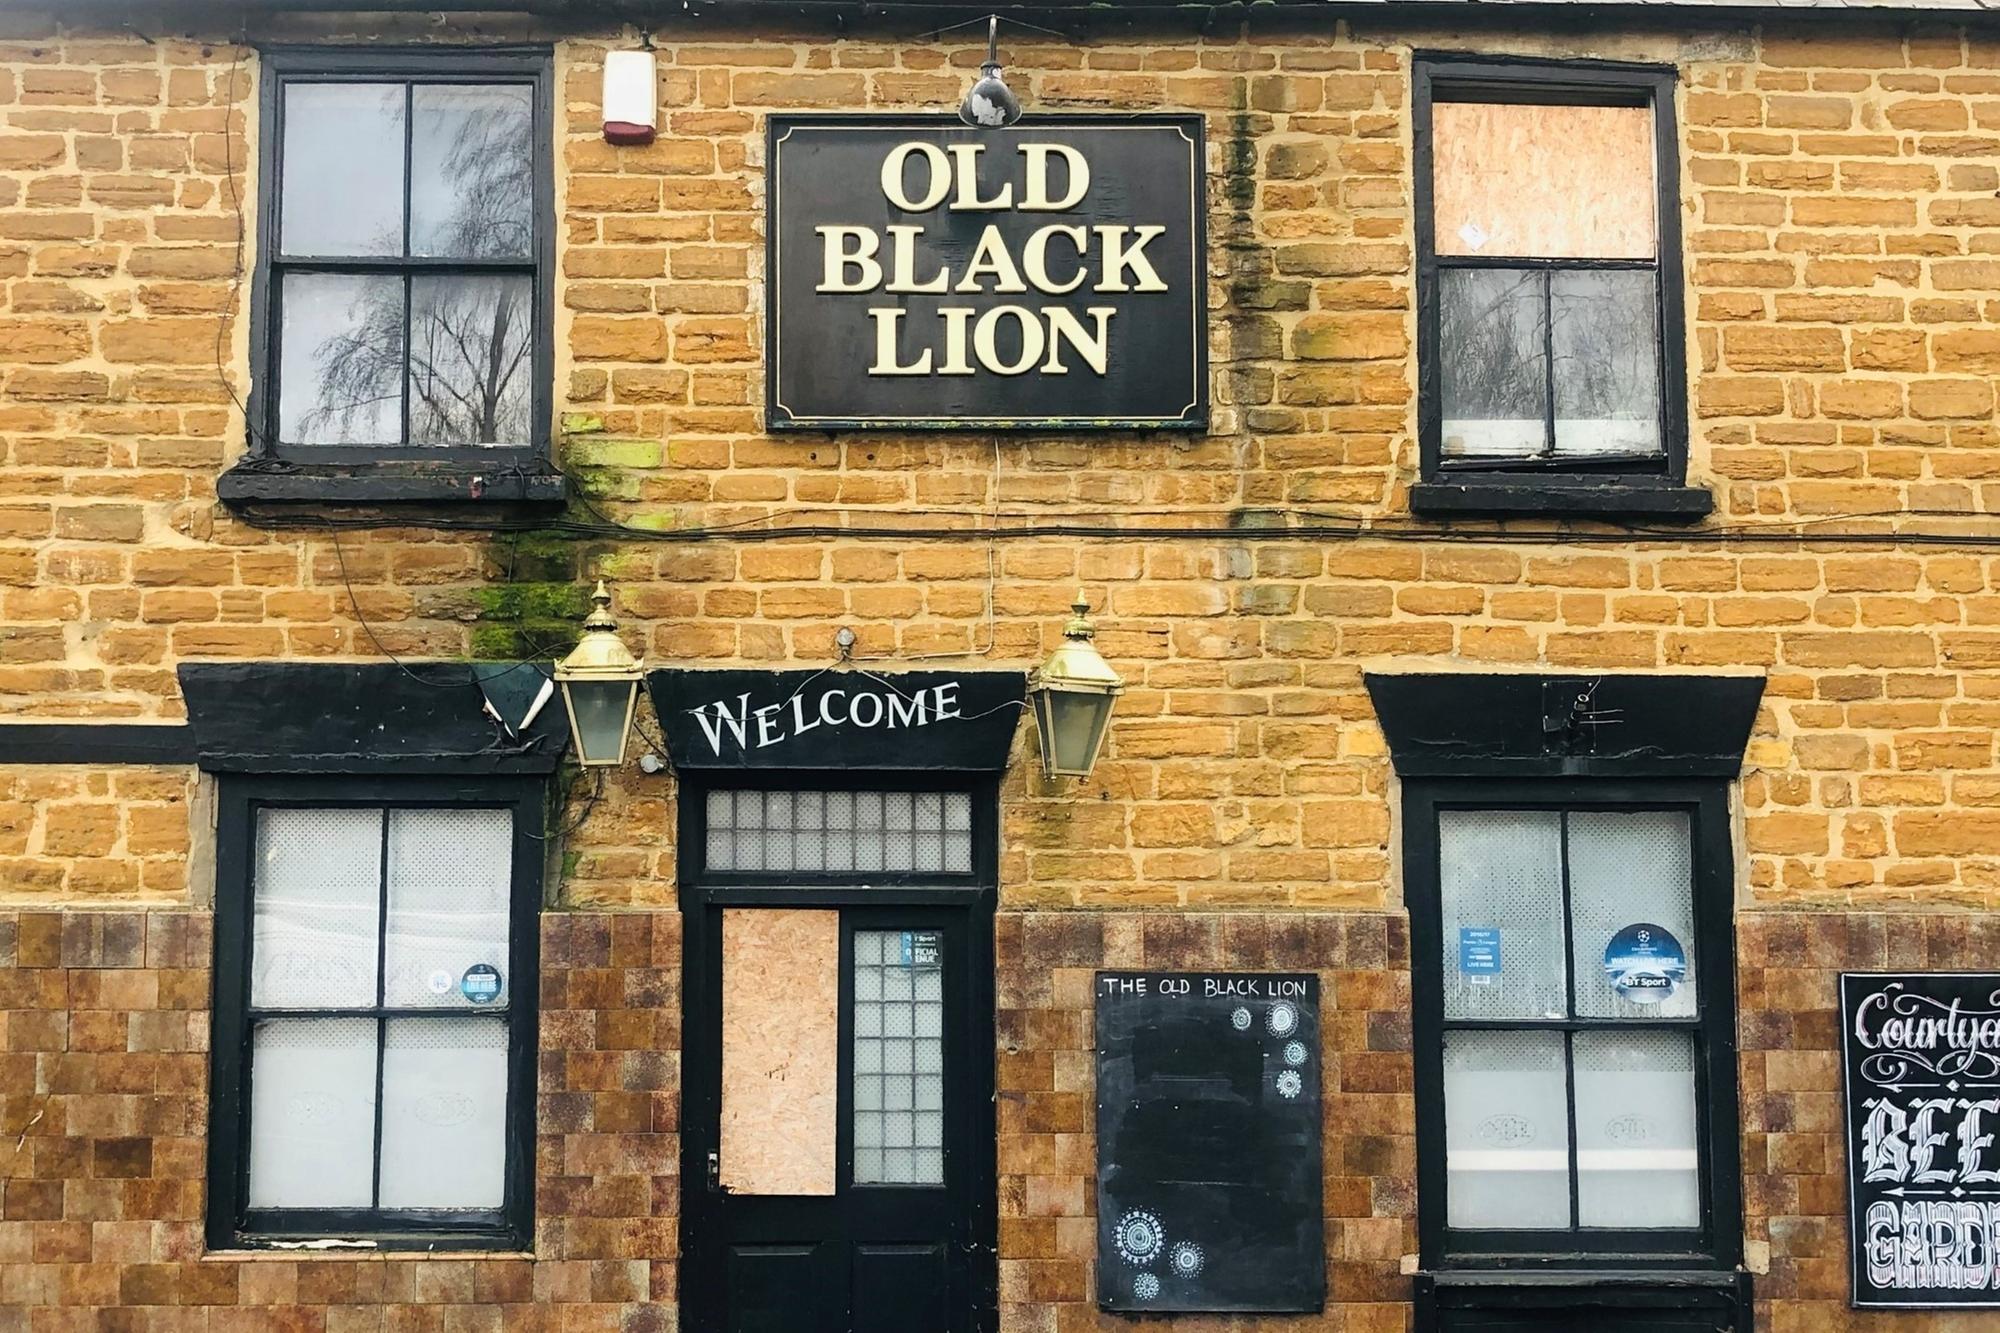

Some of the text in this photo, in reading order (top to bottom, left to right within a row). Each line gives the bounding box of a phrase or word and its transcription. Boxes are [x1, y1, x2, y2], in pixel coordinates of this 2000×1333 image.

[880, 141, 1090, 213] OLD
[815, 224, 1168, 294] BLACK
[868, 305, 1117, 376] LION
[688, 681, 961, 757] WELCOME
[905, 947, 939, 956] OFICIAL
[1641, 977, 1666, 987] Sport
[1102, 977, 1307, 997] THE OLD BLACK LION
